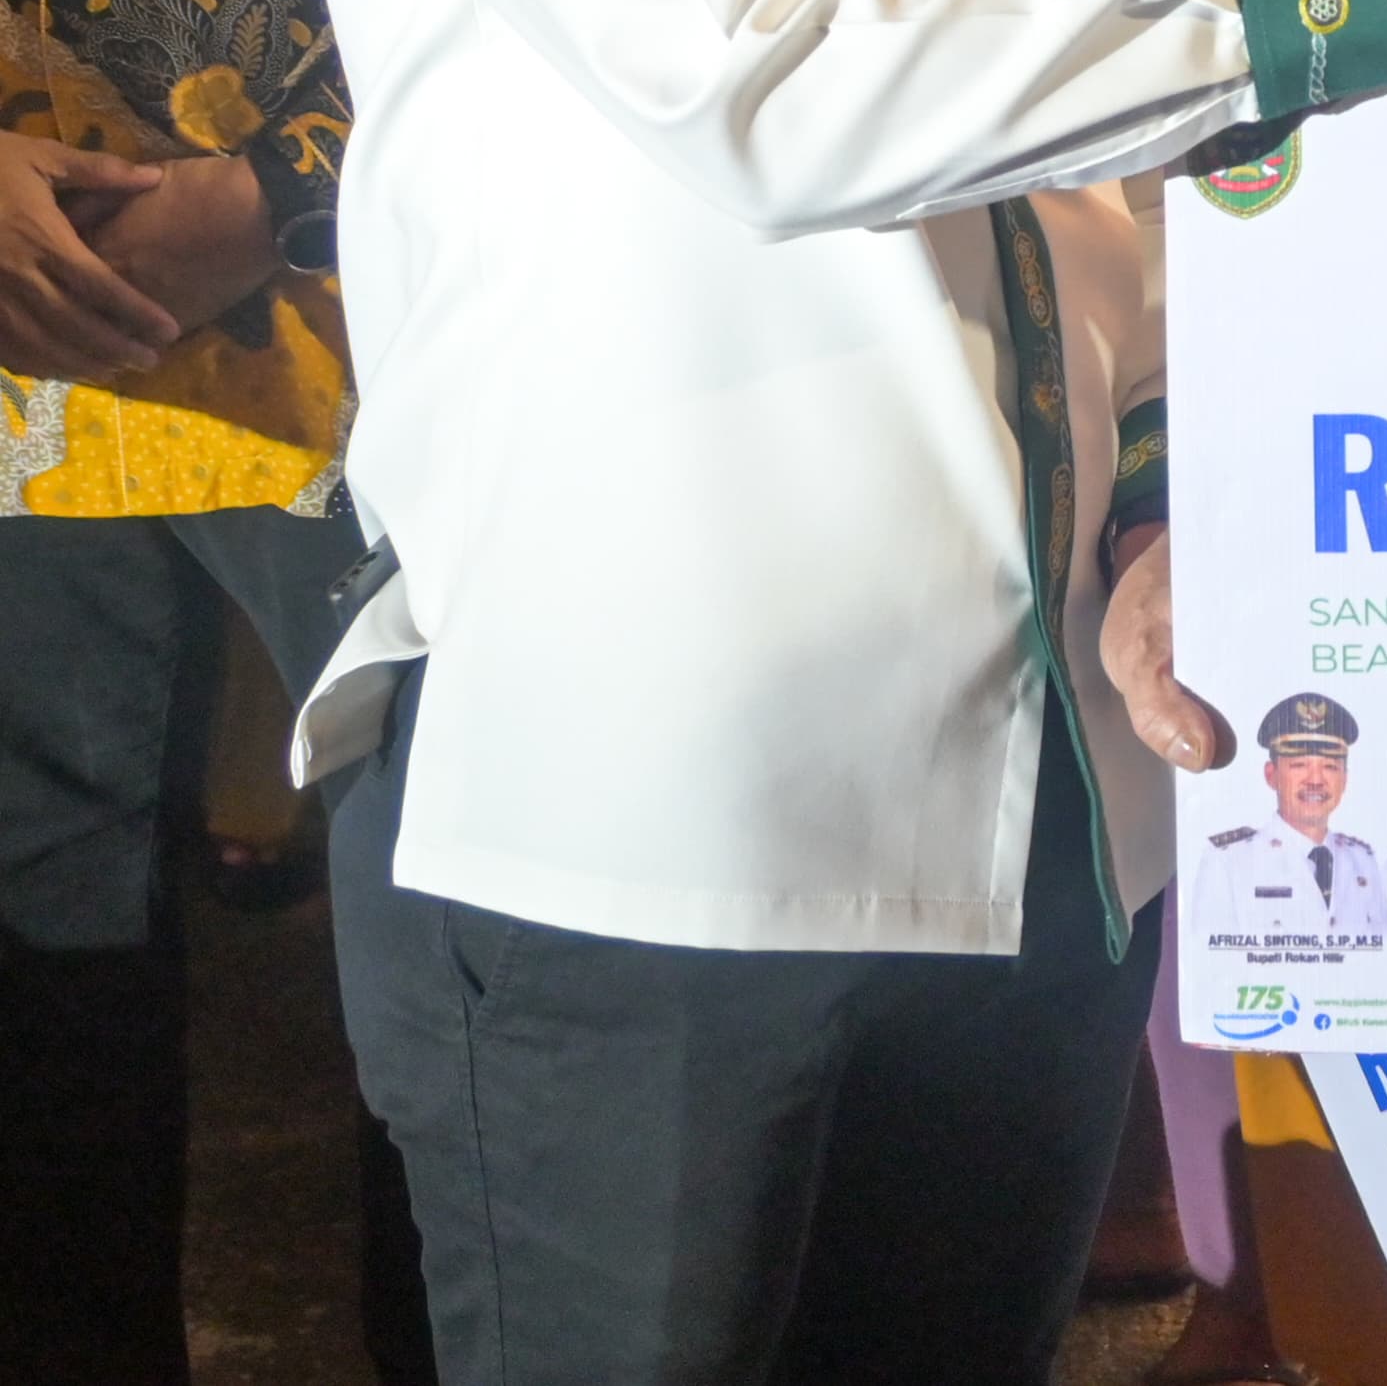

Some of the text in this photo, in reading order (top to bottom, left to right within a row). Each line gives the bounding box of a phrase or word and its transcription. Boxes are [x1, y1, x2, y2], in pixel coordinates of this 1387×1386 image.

[1208, 934, 1261, 947] AFRIZAL
[1263, 934, 1323, 949] SINTONG,
[1246, 952, 1345, 965] Bupati Rokan Hilir
[1236, 985, 1286, 1011] 175
